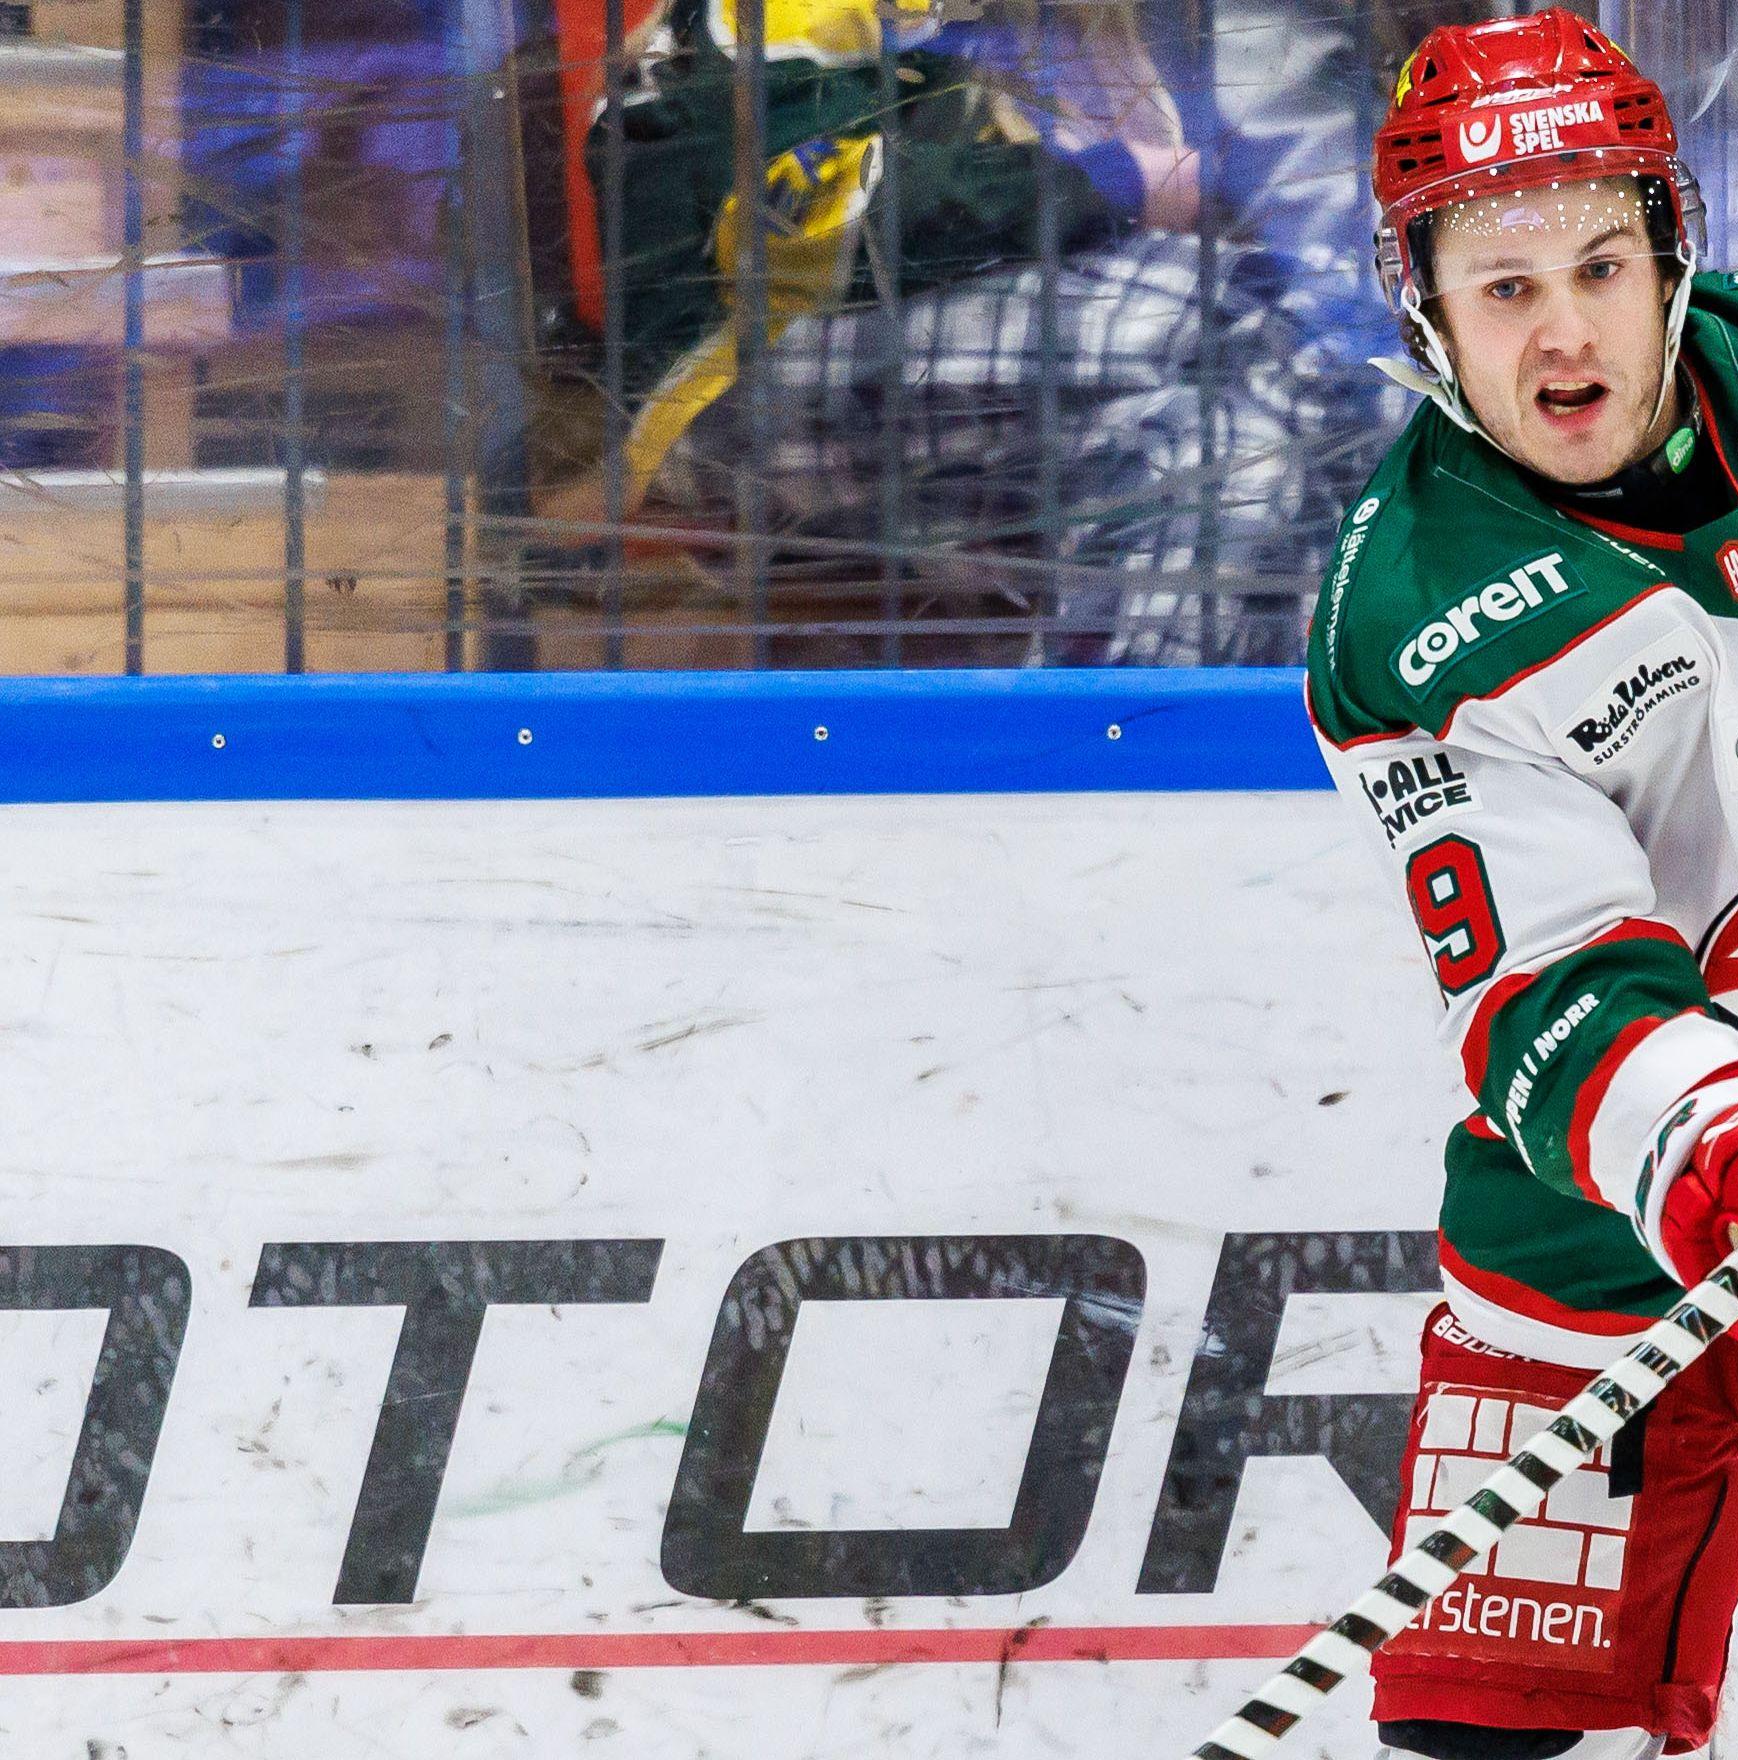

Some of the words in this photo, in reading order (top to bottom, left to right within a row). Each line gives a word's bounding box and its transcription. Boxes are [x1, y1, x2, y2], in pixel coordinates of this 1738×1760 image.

[1509, 100, 1604, 135] SVENSKA
[1513, 128, 1564, 156] SPEL
[1593, 675, 1700, 765] SURSTRÖMMING
[1385, 782, 1472, 836] VICE
[1406, 832, 1507, 997] 9
[1533, 993, 1600, 1061] NORR
[1407, 1582, 1611, 1648] rstenen.
